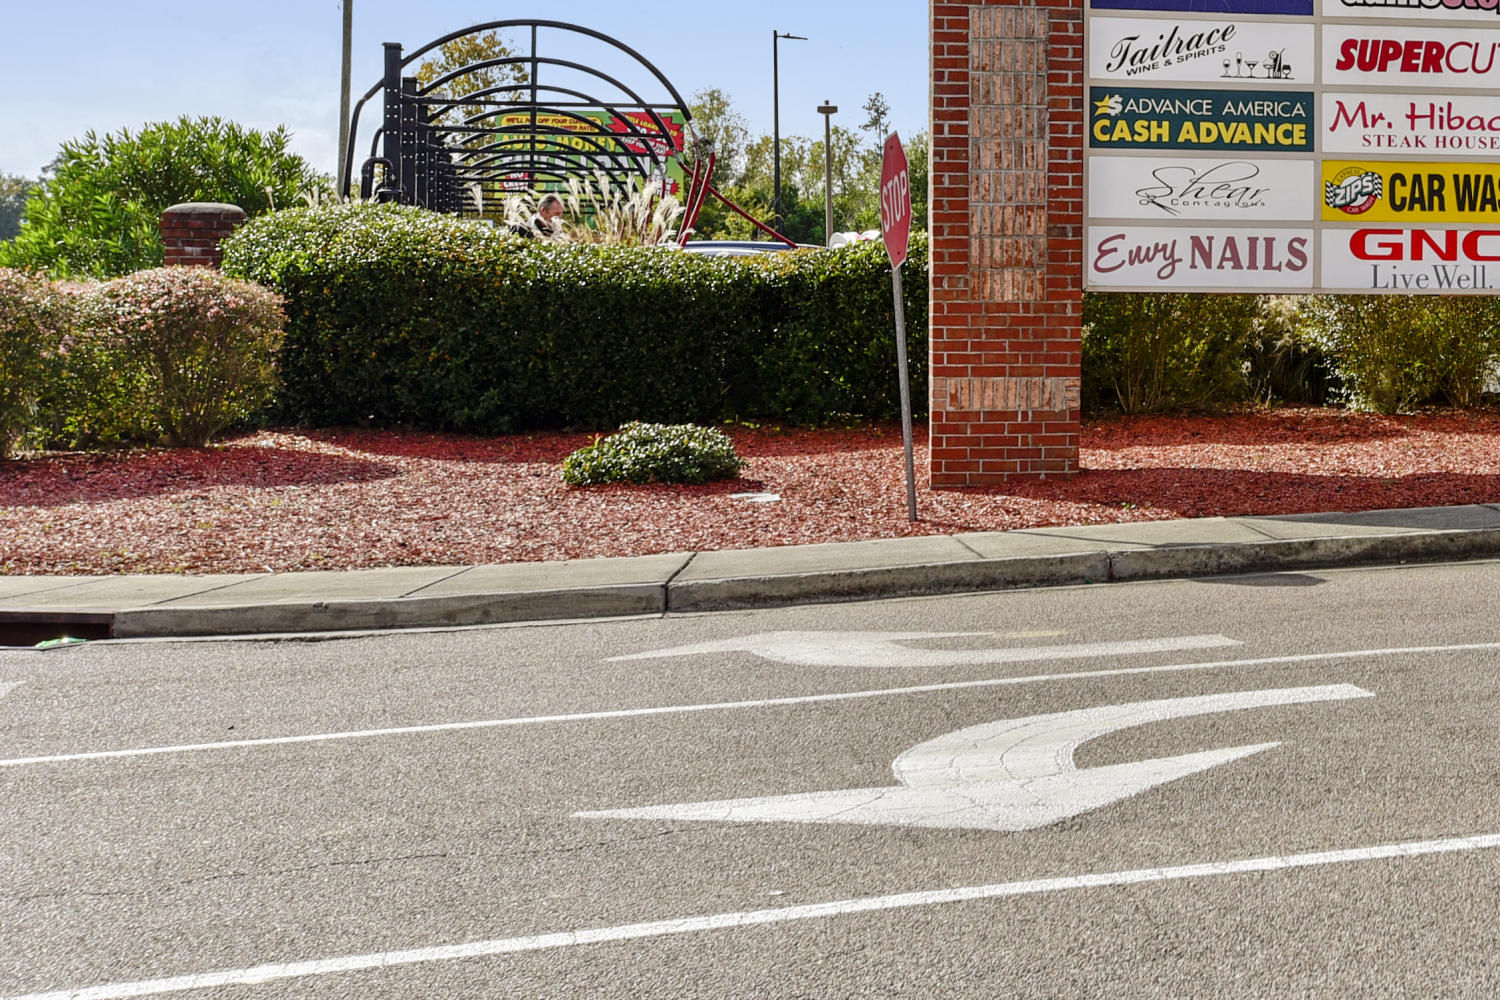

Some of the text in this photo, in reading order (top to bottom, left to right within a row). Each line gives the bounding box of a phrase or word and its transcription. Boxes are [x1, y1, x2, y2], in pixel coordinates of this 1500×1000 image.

[1105, 23, 1238, 73] Tailrace
[1126, 44, 1226, 77] WINE & SPIRITS
[1124, 98, 1213, 116] ADVANCE
[1222, 101, 1306, 118] AMERICA
[1329, 100, 1393, 132] Mr.
[1093, 118, 1307, 145] CASH ADVANCE
[1362, 134, 1500, 150] STEAK HOUSE
[882, 169, 907, 233] STOP
[1135, 161, 1270, 208] Shear
[1334, 175, 1374, 205] ZIPS
[1388, 173, 1446, 212] CAR
[1093, 233, 1308, 280] Envy NAILS
